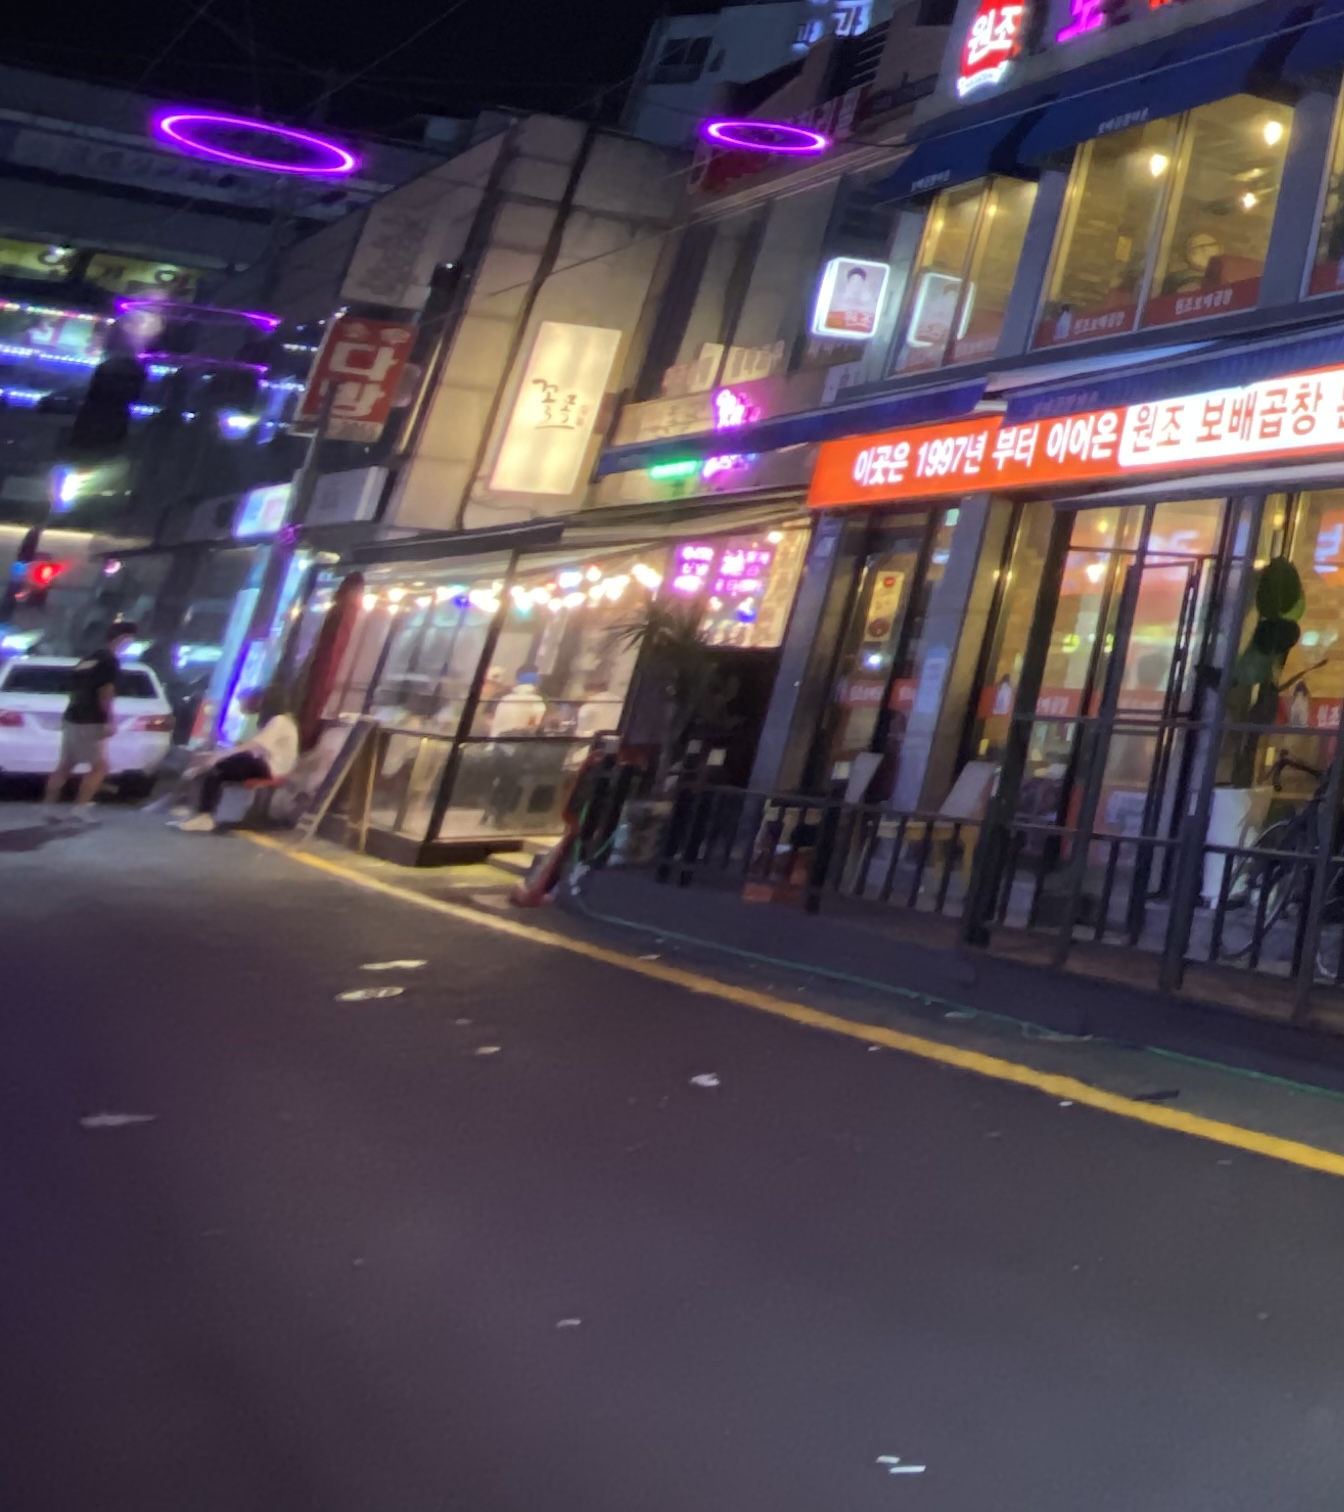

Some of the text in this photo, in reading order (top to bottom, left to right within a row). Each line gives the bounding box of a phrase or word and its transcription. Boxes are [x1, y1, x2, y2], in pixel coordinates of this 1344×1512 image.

[967, 4, 1023, 66] 원조
[851, 444, 911, 486] 이곳은
[914, 434, 986, 480] 1997년
[991, 426, 1038, 471] 부터
[1046, 414, 1119, 464] 이어온
[1128, 402, 1183, 455] 원조
[1194, 382, 1324, 445] 보배곱창
